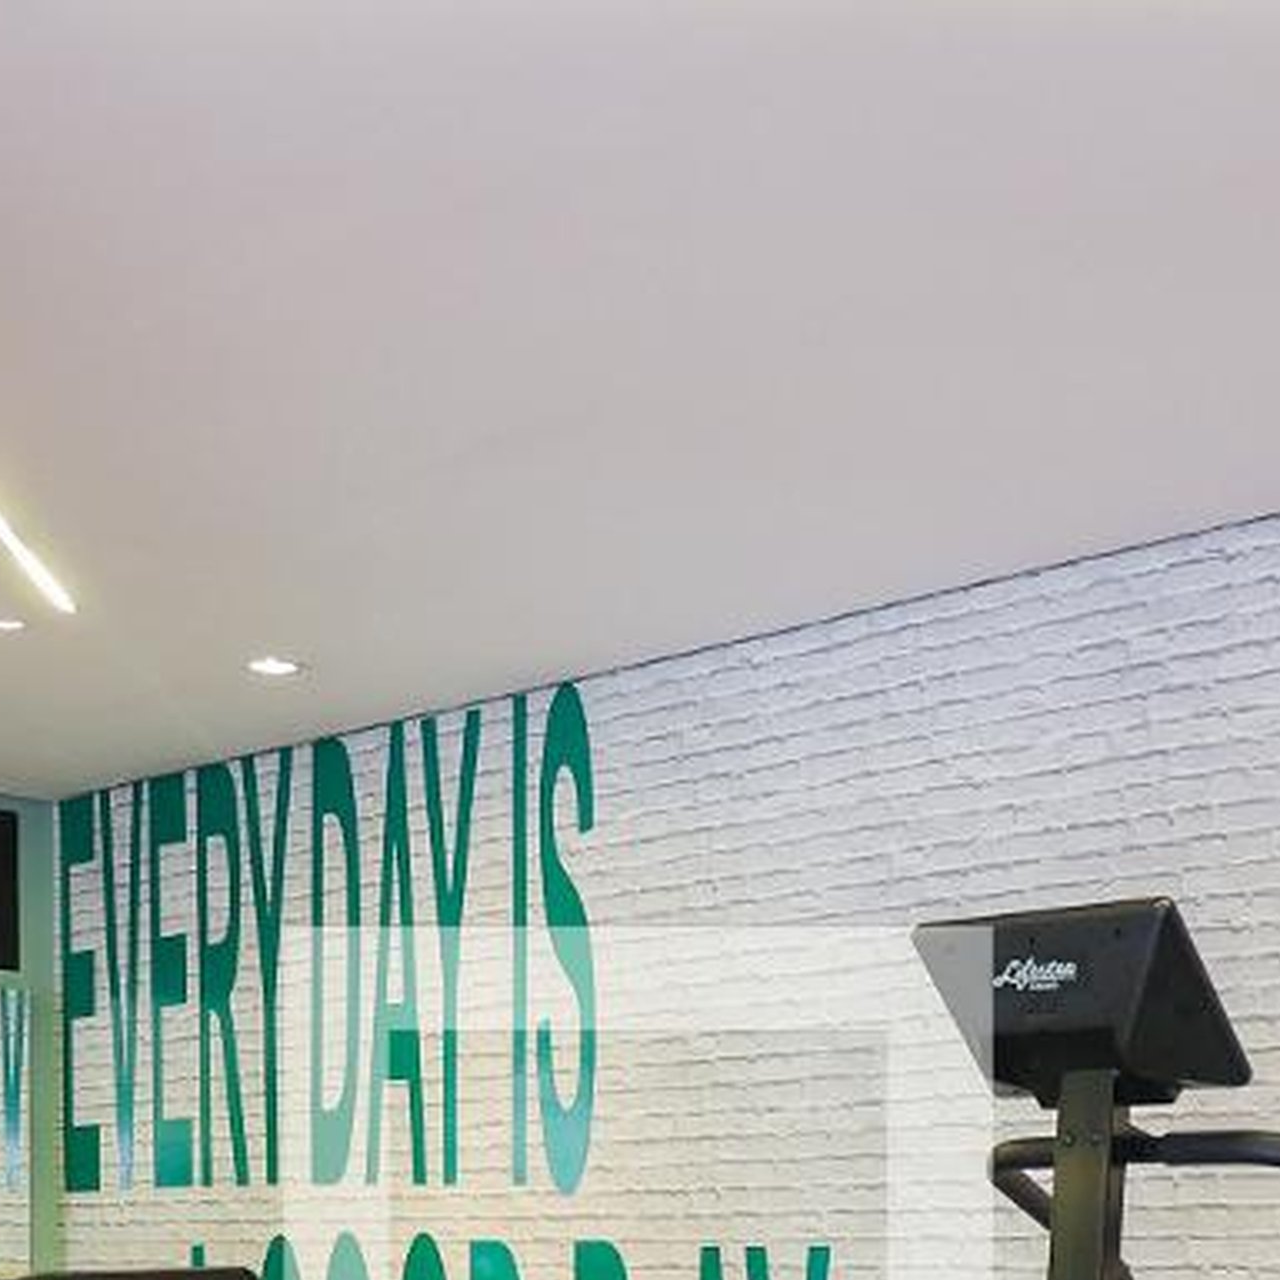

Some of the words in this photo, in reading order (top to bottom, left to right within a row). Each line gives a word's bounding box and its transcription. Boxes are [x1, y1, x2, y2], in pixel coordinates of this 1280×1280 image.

[58, 745, 292, 1192] EVERY
[310, 709, 481, 1187] DAY
[511, 680, 596, 1196] IS
